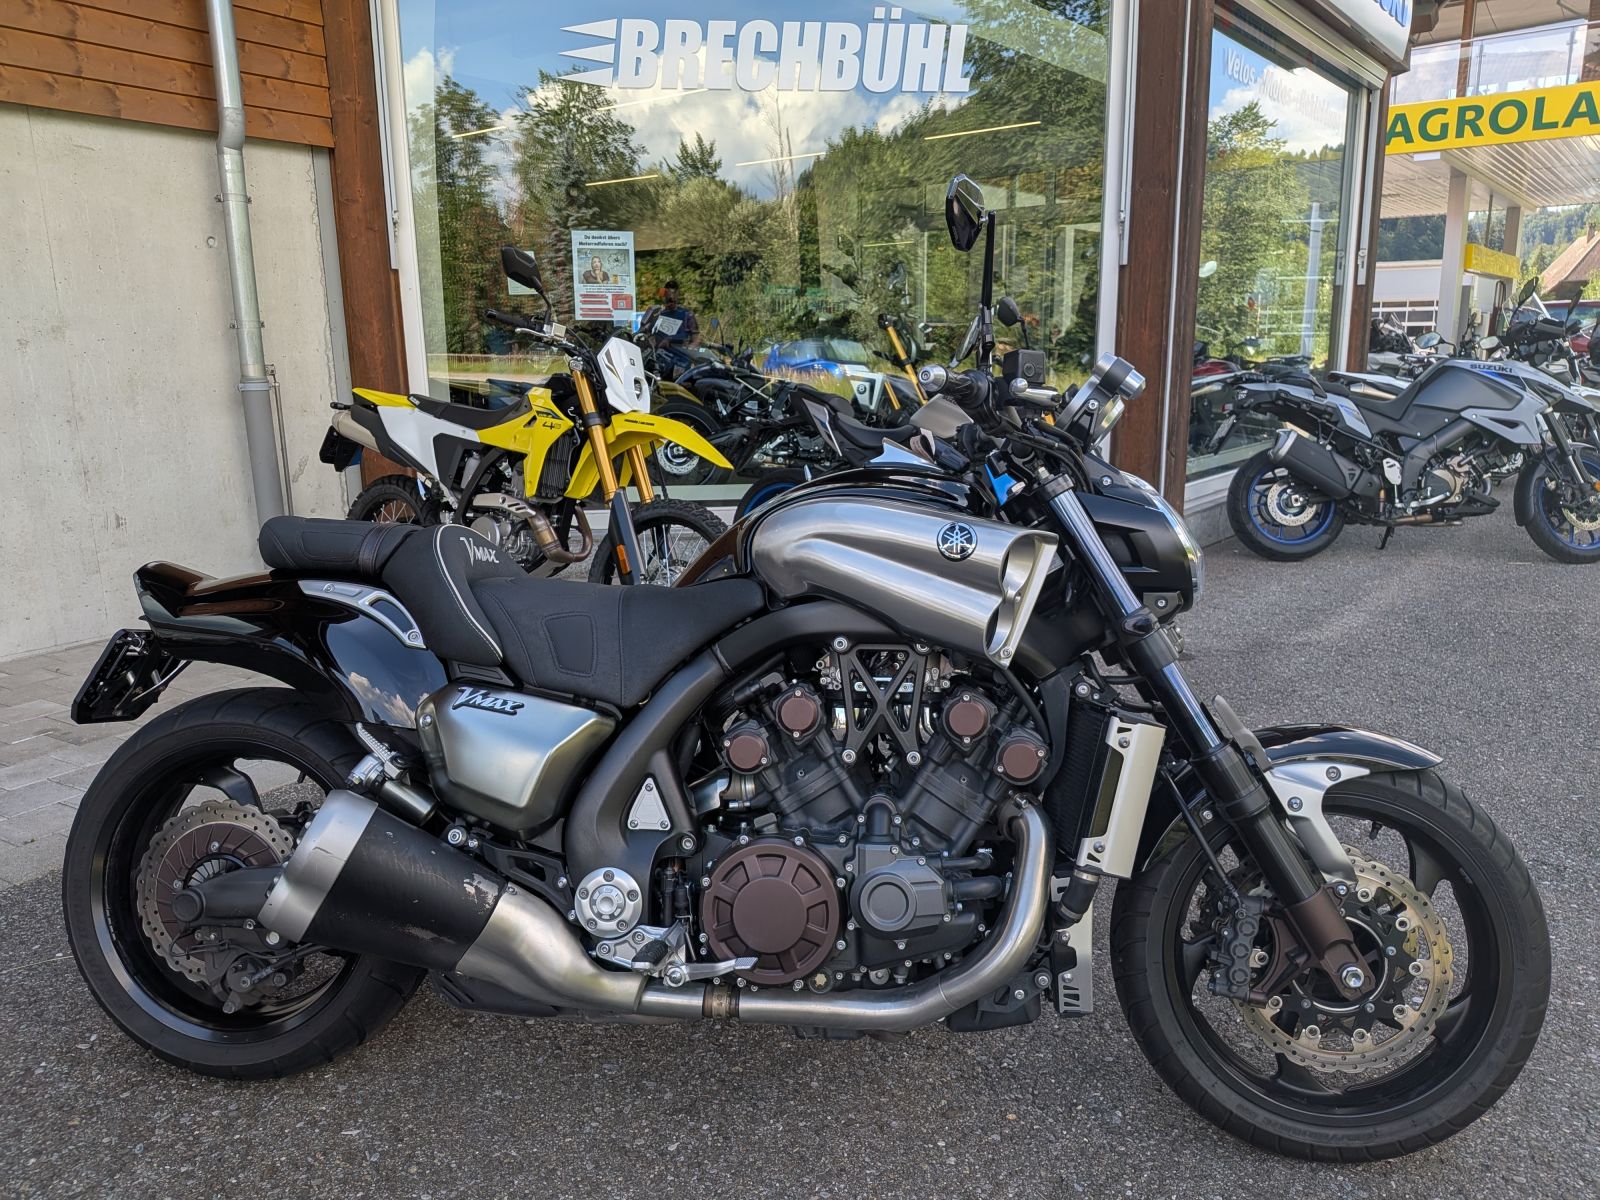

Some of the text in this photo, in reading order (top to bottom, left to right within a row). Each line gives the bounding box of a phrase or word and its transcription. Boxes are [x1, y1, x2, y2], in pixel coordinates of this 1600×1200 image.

[617, 7, 970, 93] BRECHBÜHL
[1386, 91, 1600, 146] AGROLA
[1470, 363, 1513, 374] SUZUKI
